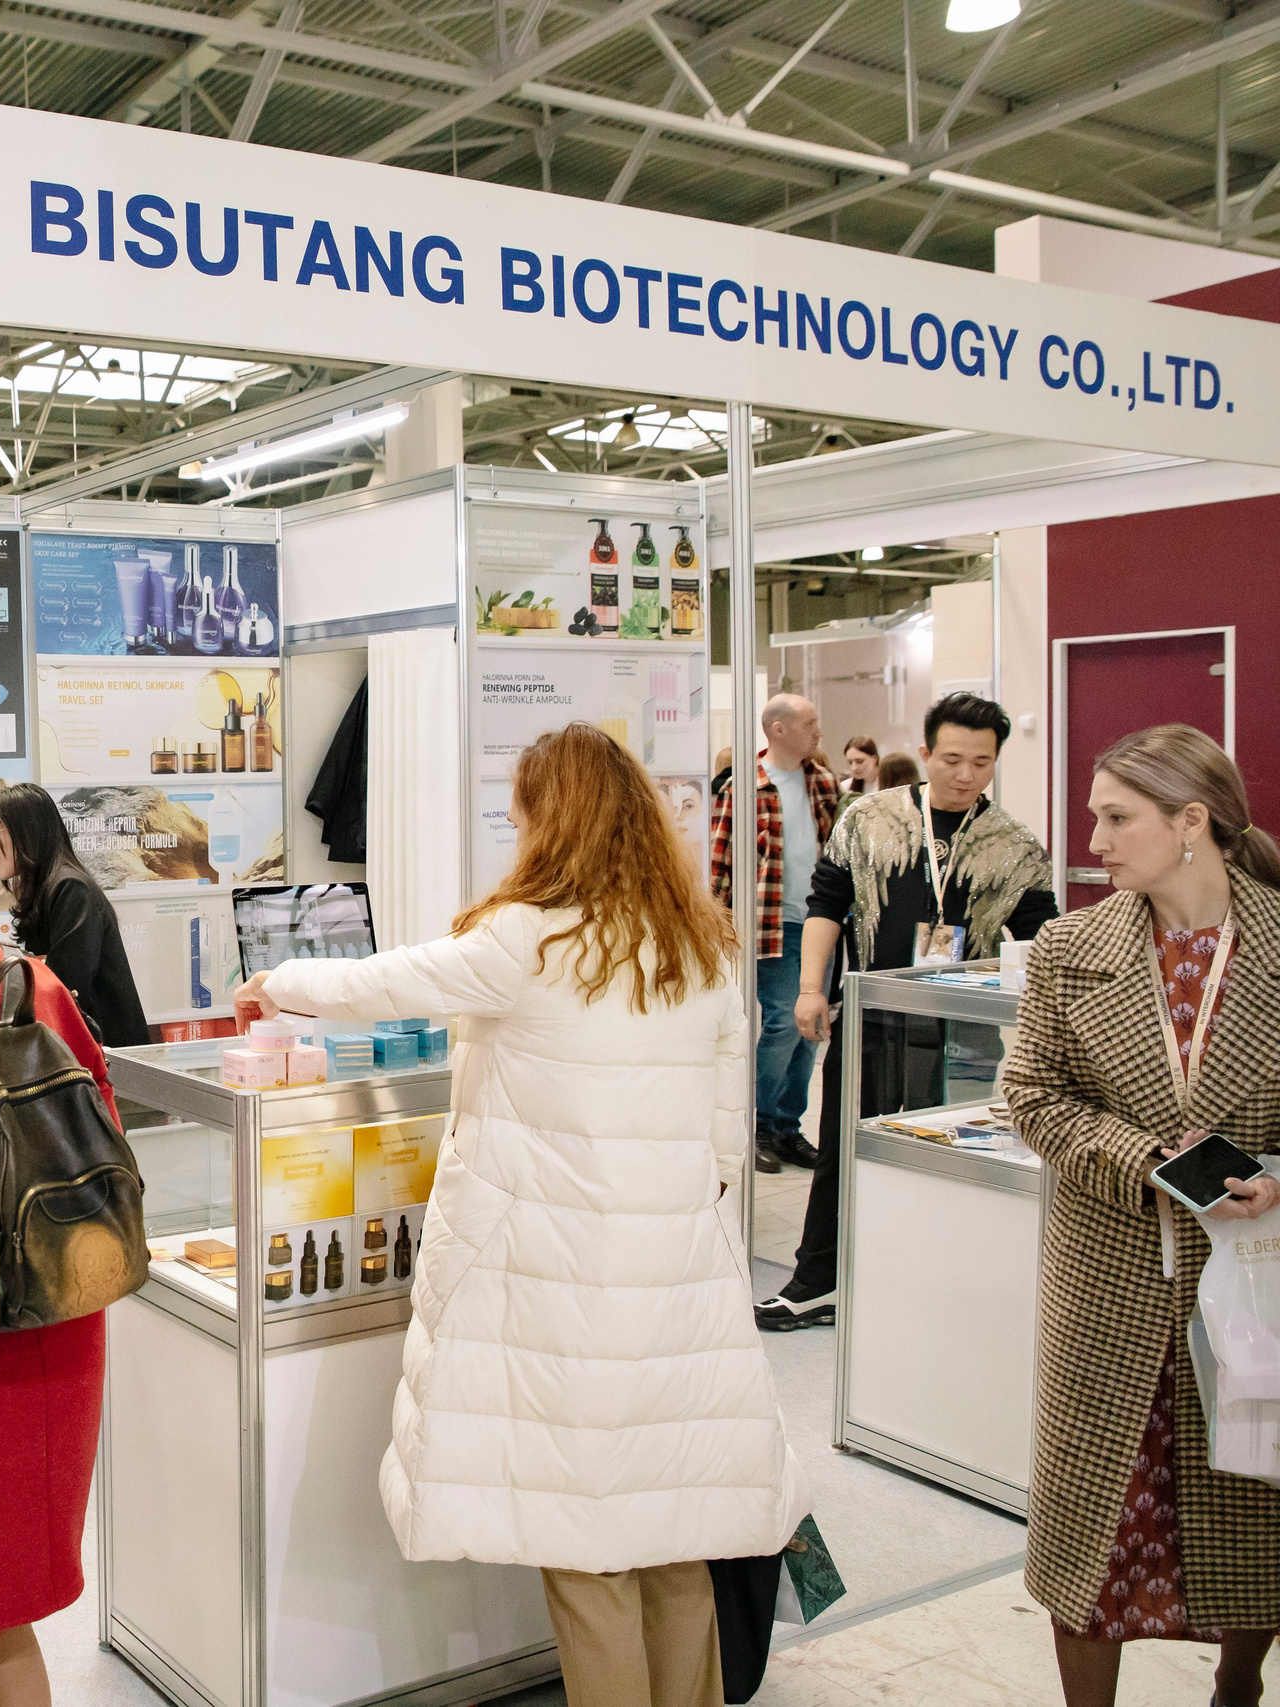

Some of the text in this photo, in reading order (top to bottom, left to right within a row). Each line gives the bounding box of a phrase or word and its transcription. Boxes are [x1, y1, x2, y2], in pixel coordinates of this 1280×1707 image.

[29, 178, 467, 306] BISUTANG
[500, 245, 1021, 382] BIOTECHNOLOGY
[1038, 333, 1237, 414] CO.,LTD.
[108, 543, 136, 551] FIRMING
[57, 680, 185, 691] HALORINNA RETINOL SKINCARE
[482, 683, 555, 693] RENEWING PEPTIDE
[58, 695, 104, 705] TRAVEL SET
[482, 694, 573, 704] ANTI-WRINKLE AMPOULE
[108, 816, 138, 832] REPAIR
[140, 833, 178, 849] FORMULA
[1156, 989, 1171, 1026] INTERCHARM
[1198, 983, 1215, 1025] by INTERCHARM
